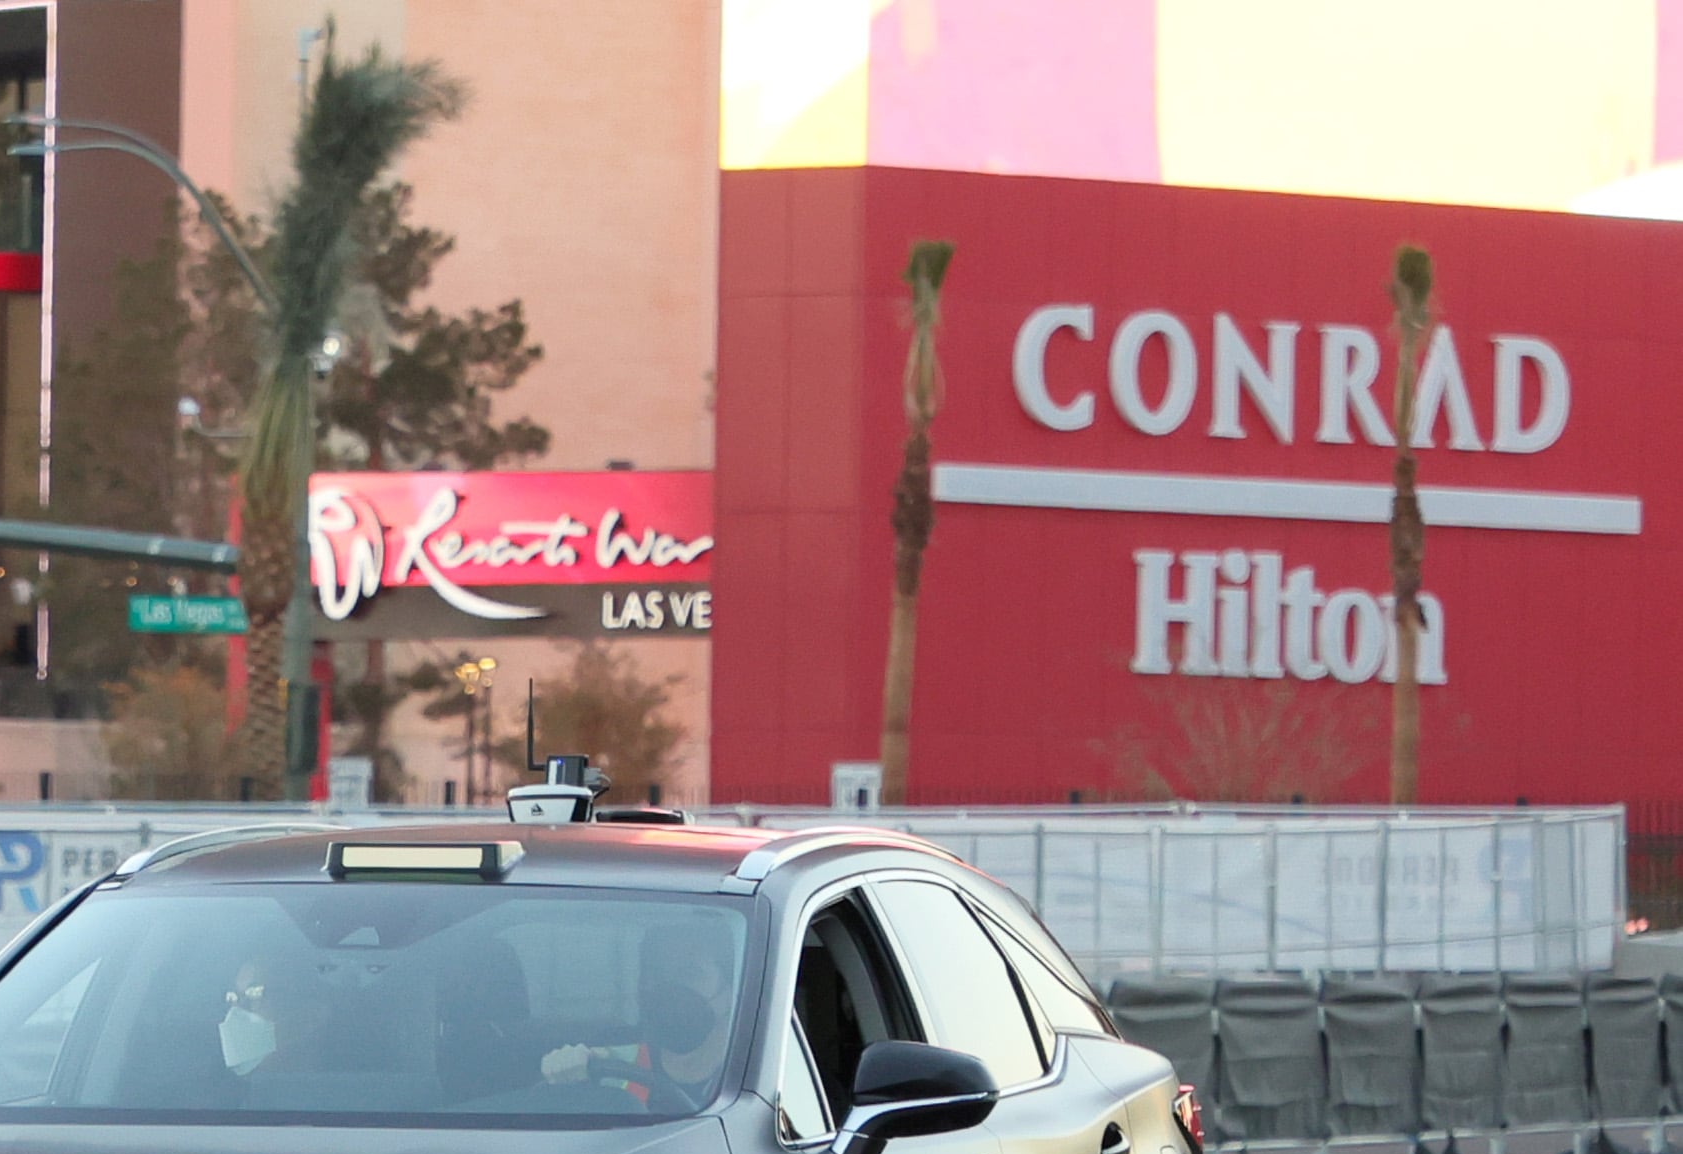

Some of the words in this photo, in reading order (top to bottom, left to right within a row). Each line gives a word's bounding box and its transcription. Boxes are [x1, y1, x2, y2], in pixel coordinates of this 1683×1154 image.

[1012, 304, 1571, 455] CONRAD
[395, 487, 588, 619] Resorts
[602, 591, 663, 629] LAS
[669, 591, 713, 629] VE
[1129, 548, 1448, 685] Hilton
